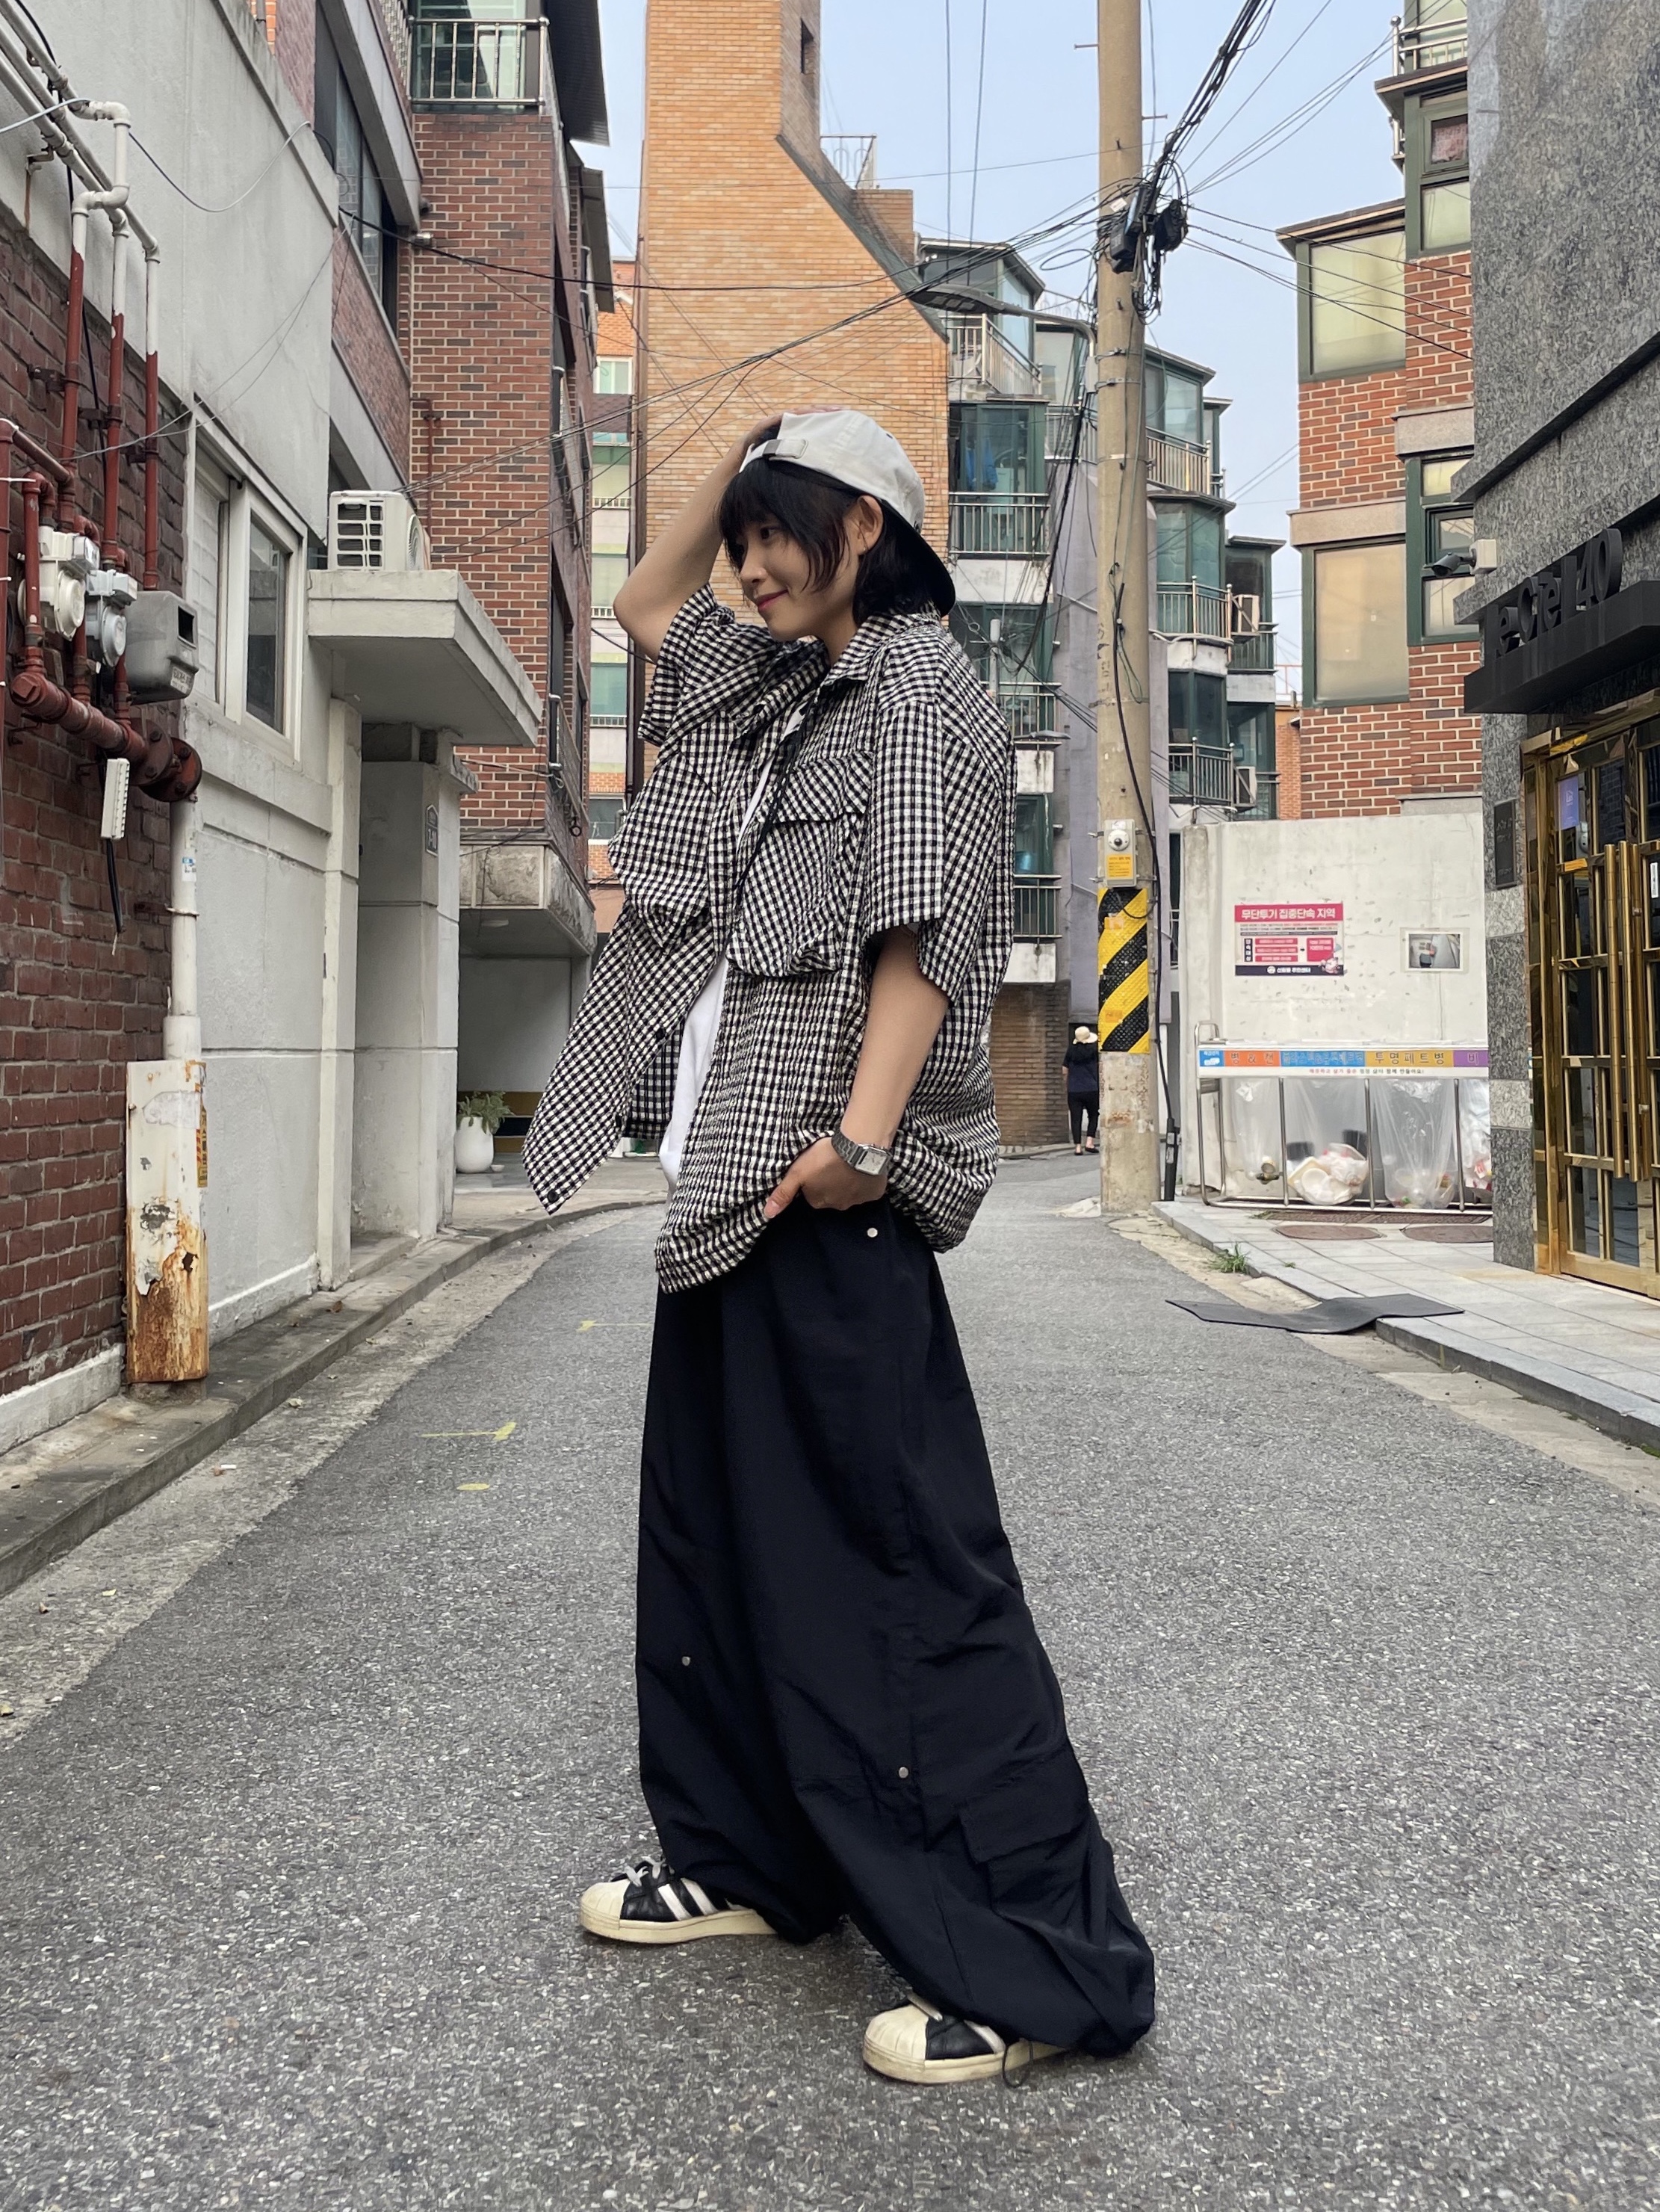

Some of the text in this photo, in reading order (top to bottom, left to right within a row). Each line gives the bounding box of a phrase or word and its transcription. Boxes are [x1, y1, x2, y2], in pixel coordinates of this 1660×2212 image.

[1242, 907, 1336, 920] 무단투기 집중단속 지역
[1230, 1052, 1240, 1065] 병
[1263, 1052, 1274, 1065] 캔
[1375, 1051, 1445, 1065] 투명페트병
